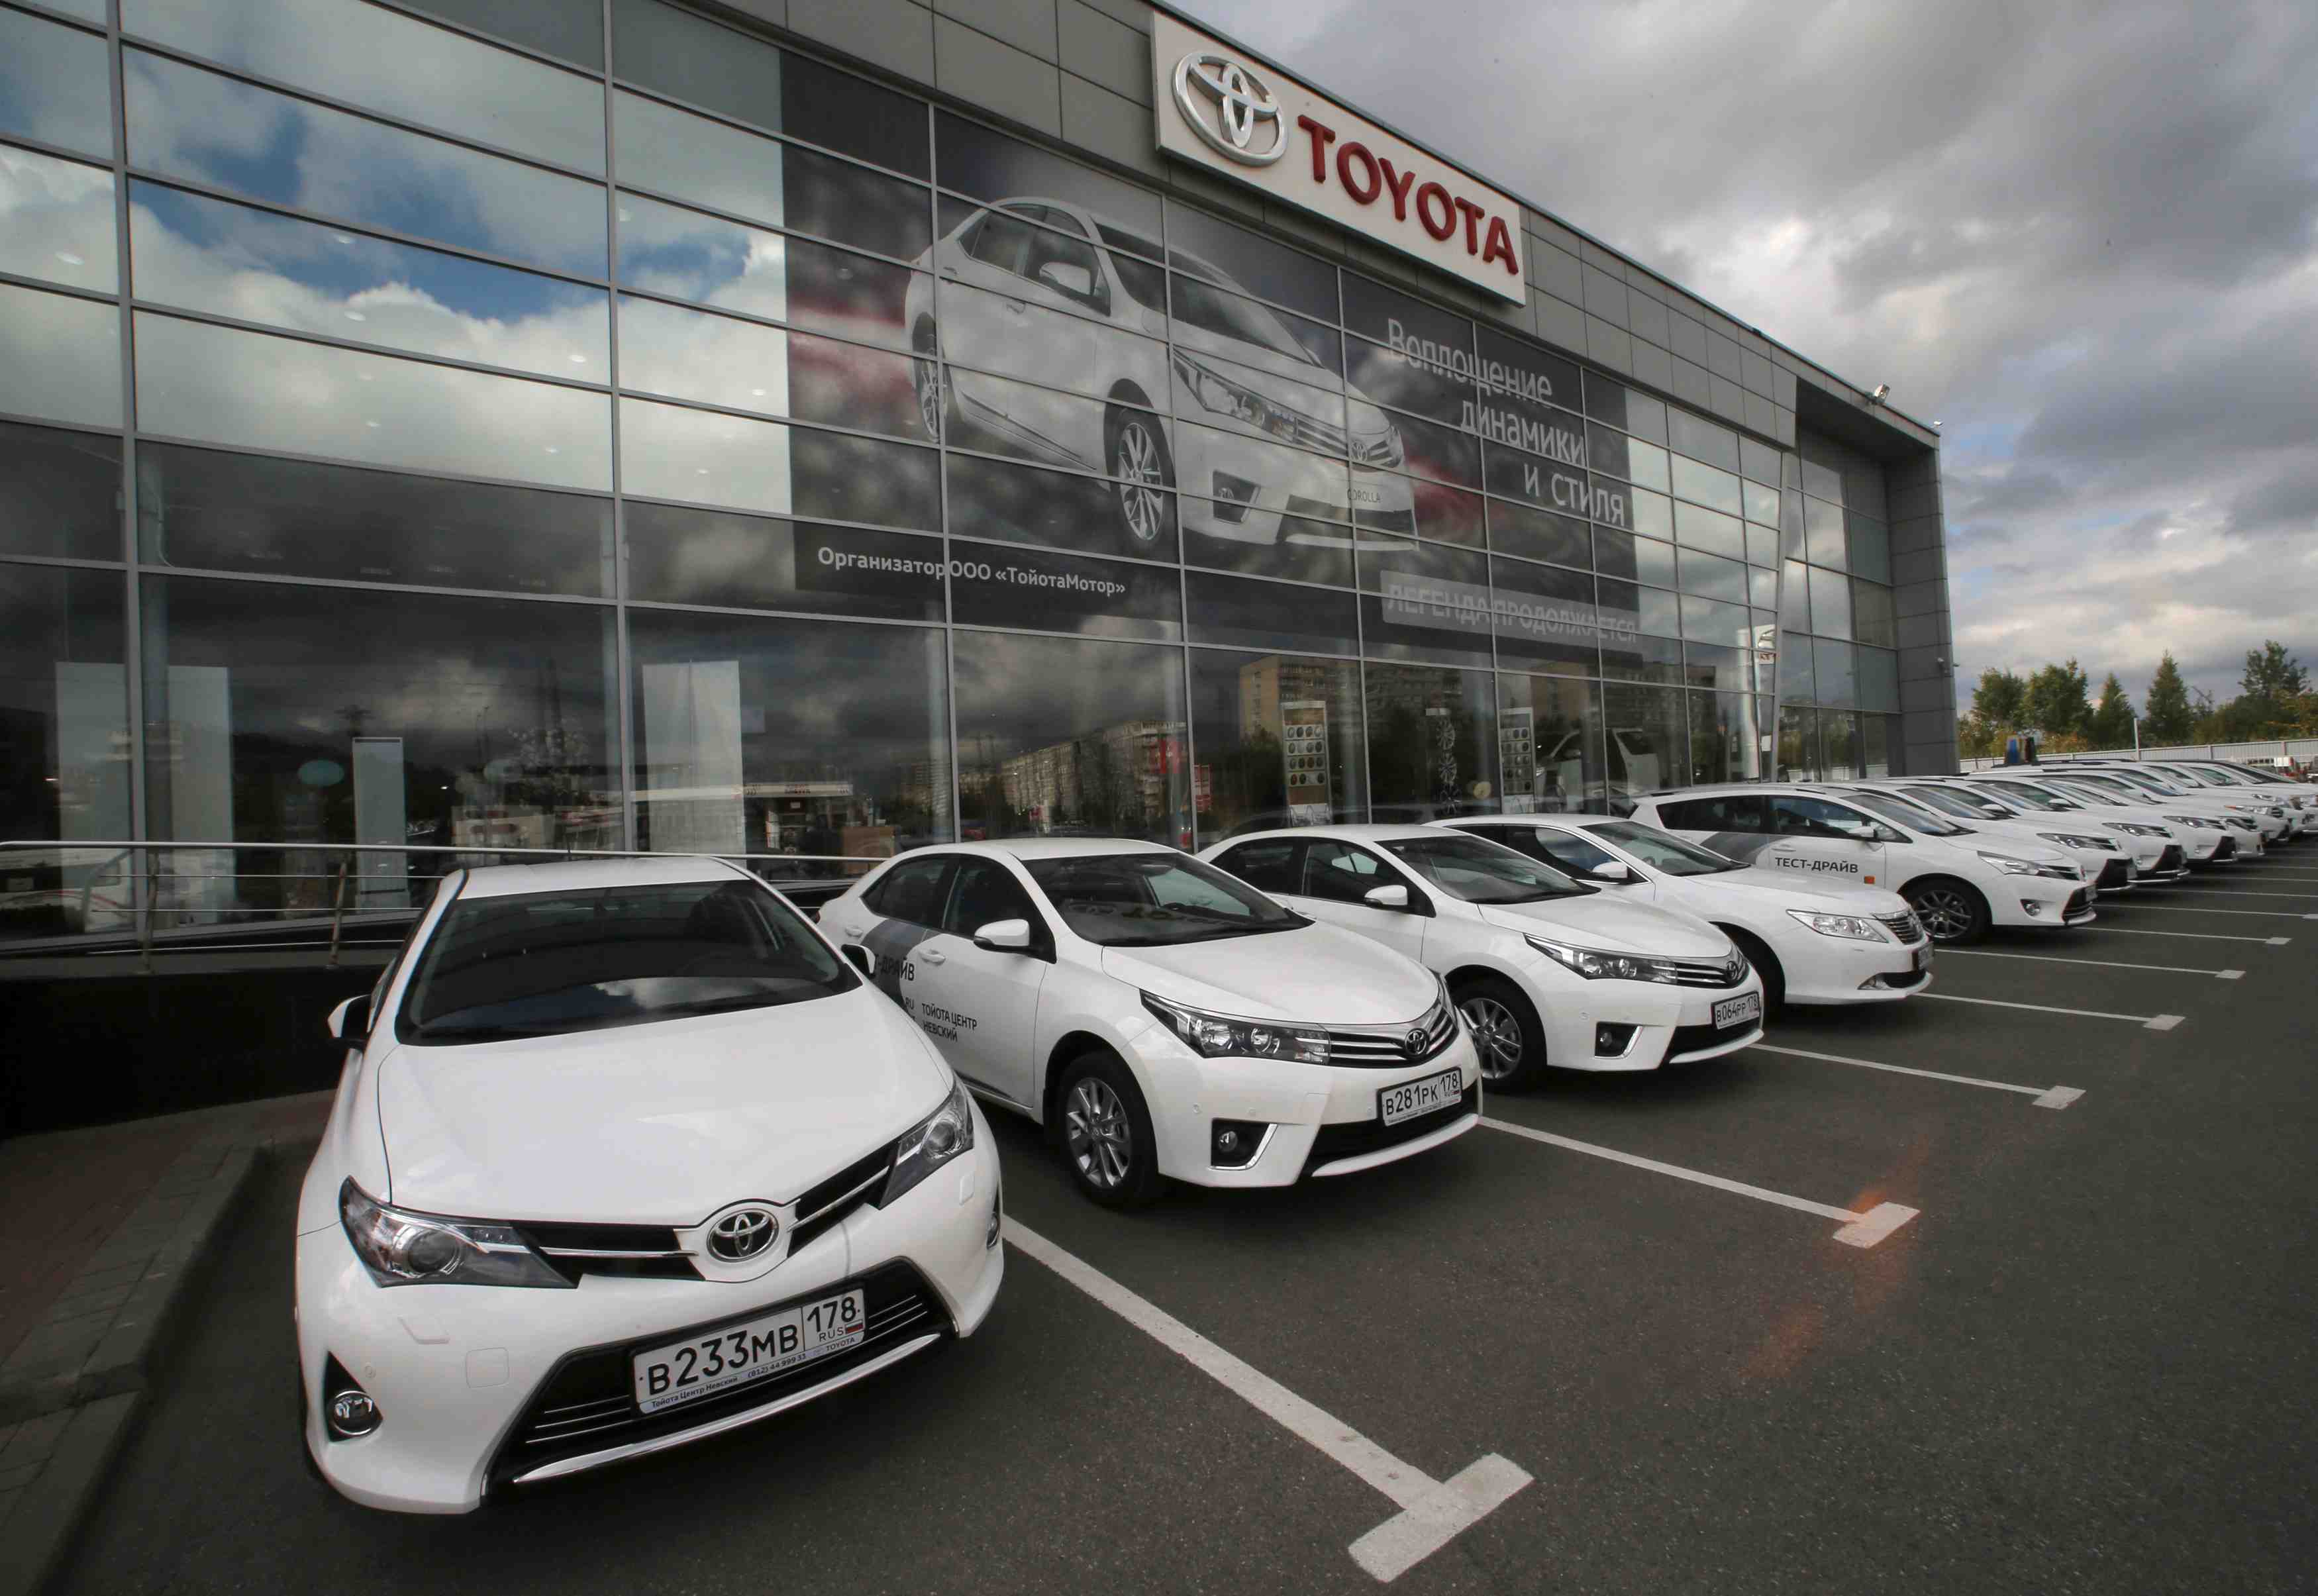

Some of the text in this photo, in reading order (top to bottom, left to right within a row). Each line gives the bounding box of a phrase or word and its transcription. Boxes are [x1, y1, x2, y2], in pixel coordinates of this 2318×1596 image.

[1297, 115, 1519, 275] TOYOTA
[1387, 318, 1553, 409] Воплощение
[1460, 401, 1586, 466] динамики
[1524, 464, 1626, 527] и стиля
[817, 546, 1125, 597] Организатор ООО «ТойотаМотор»
[1387, 583, 1637, 644] ЛЕГЕНДА ПРОДОЛЖАЕТСЯ
[1775, 856, 1858, 873] ТЕСТ-ДРАЙВ
[921, 1003, 977, 1030] ТОЙОТА ЦЕНТР
[922, 1020, 958, 1042] НЕВСКИЙ
[1386, 1085, 1438, 1116] В281РК
[1440, 1072, 1458, 1092] 178
[648, 1296, 856, 1396] В233МВ 178
[819, 1326, 844, 1343] RUS
[652, 1395, 679, 1409] Тойота
[679, 1388, 705, 1399] Центр
[706, 1376, 738, 1391] Невский
[826, 1336, 856, 1351] TOYOTA
